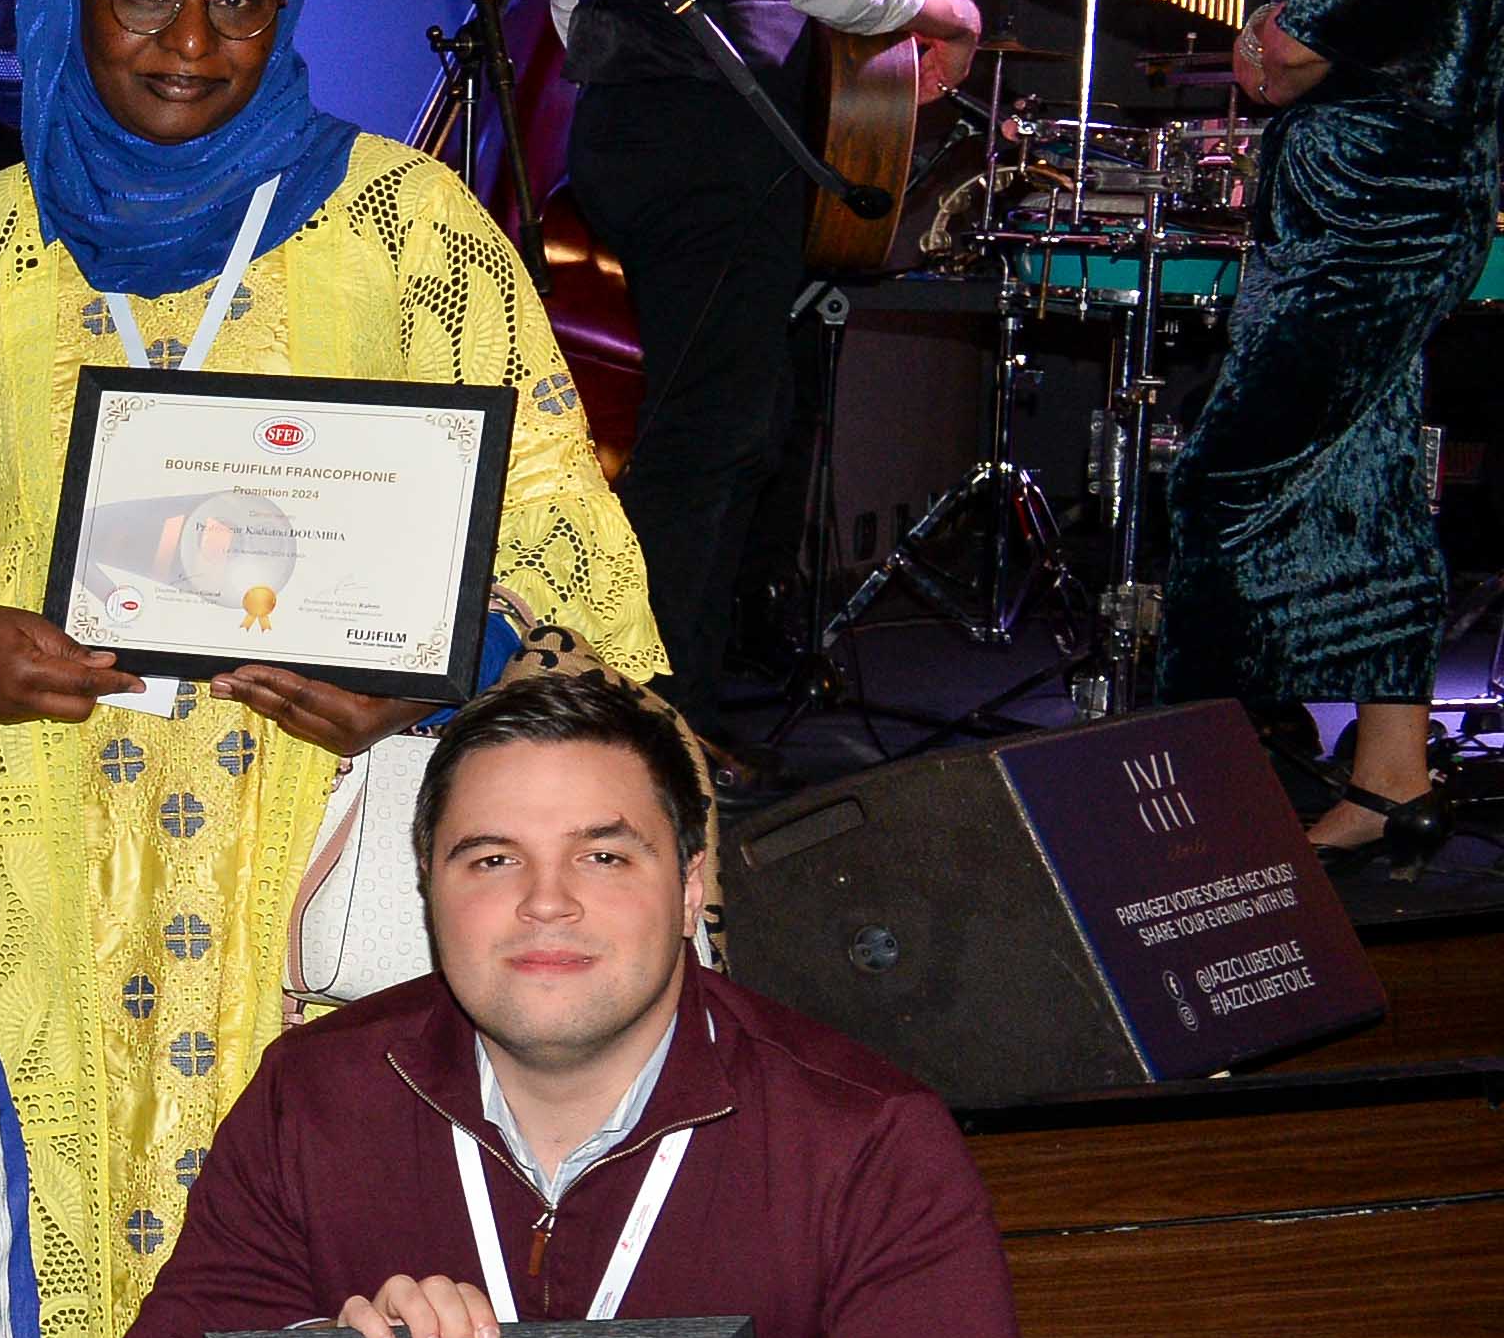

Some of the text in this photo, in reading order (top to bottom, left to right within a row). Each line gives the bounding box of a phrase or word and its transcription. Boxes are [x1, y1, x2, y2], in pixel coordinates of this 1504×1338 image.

[266, 428, 303, 443] SFED
[165, 459, 398, 484] BOURSE FUJIFILM FRANCOPHONIE
[233, 486, 320, 500] Promotion 2024
[289, 528, 346, 541] DOUMBIA
[347, 628, 407, 643] FUJIFILM
[1116, 896, 1172, 926] PARTAGEZ
[1170, 887, 1203, 912] VOTRE
[1201, 874, 1240, 903] SOIRÉE
[1238, 871, 1266, 895] AVEC
[1138, 887, 1299, 947] SHARE YOUR EVENING WITH US!
[1196, 940, 1304, 993] @JAZZCLUBETOILE
[1209, 966, 1316, 1016] #JAZZCLUBETOILE
